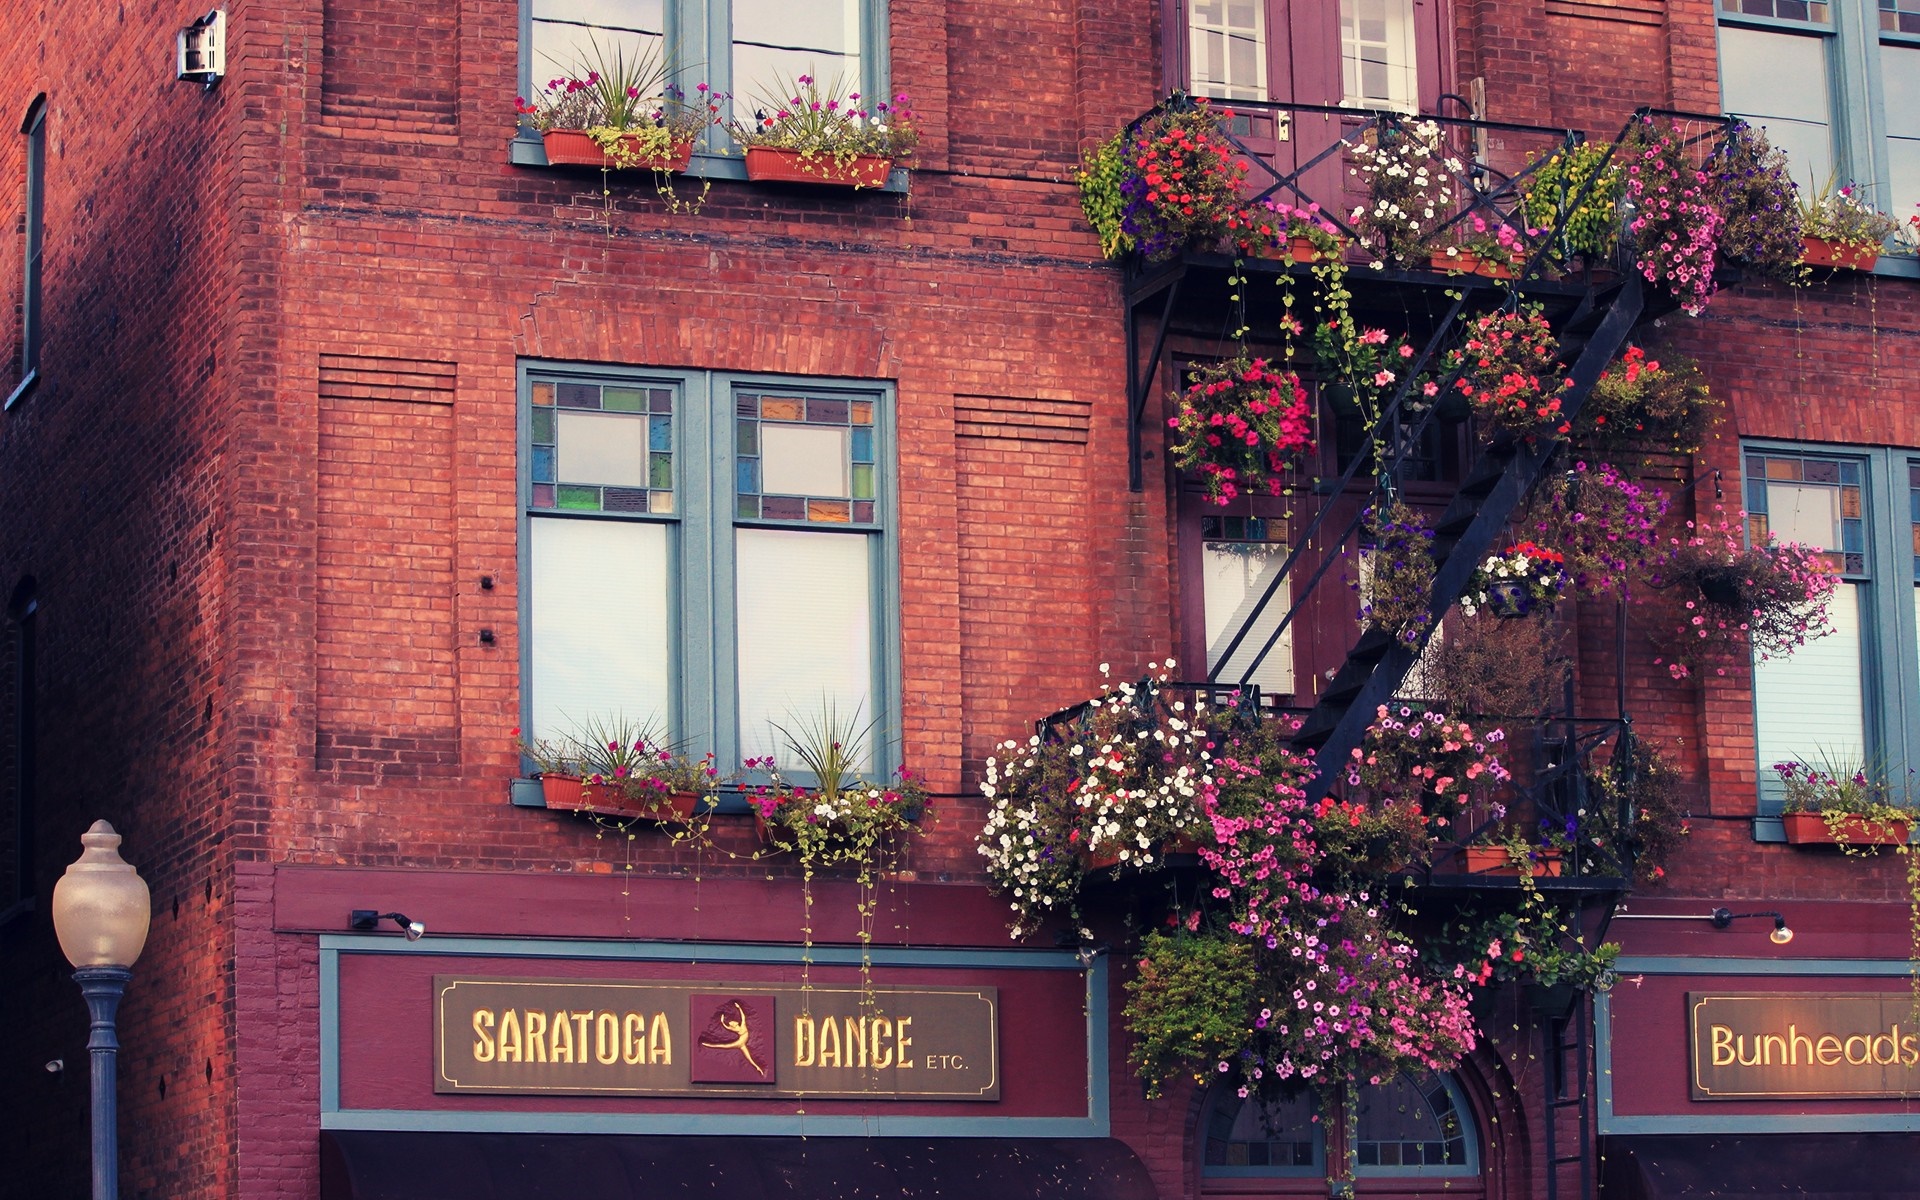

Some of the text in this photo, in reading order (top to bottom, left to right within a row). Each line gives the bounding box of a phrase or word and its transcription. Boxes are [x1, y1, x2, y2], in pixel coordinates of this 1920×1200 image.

[472, 1008, 970, 1070] SARATOGA DANCE ETC.
[1710, 1023, 1920, 1066] Bunheads
